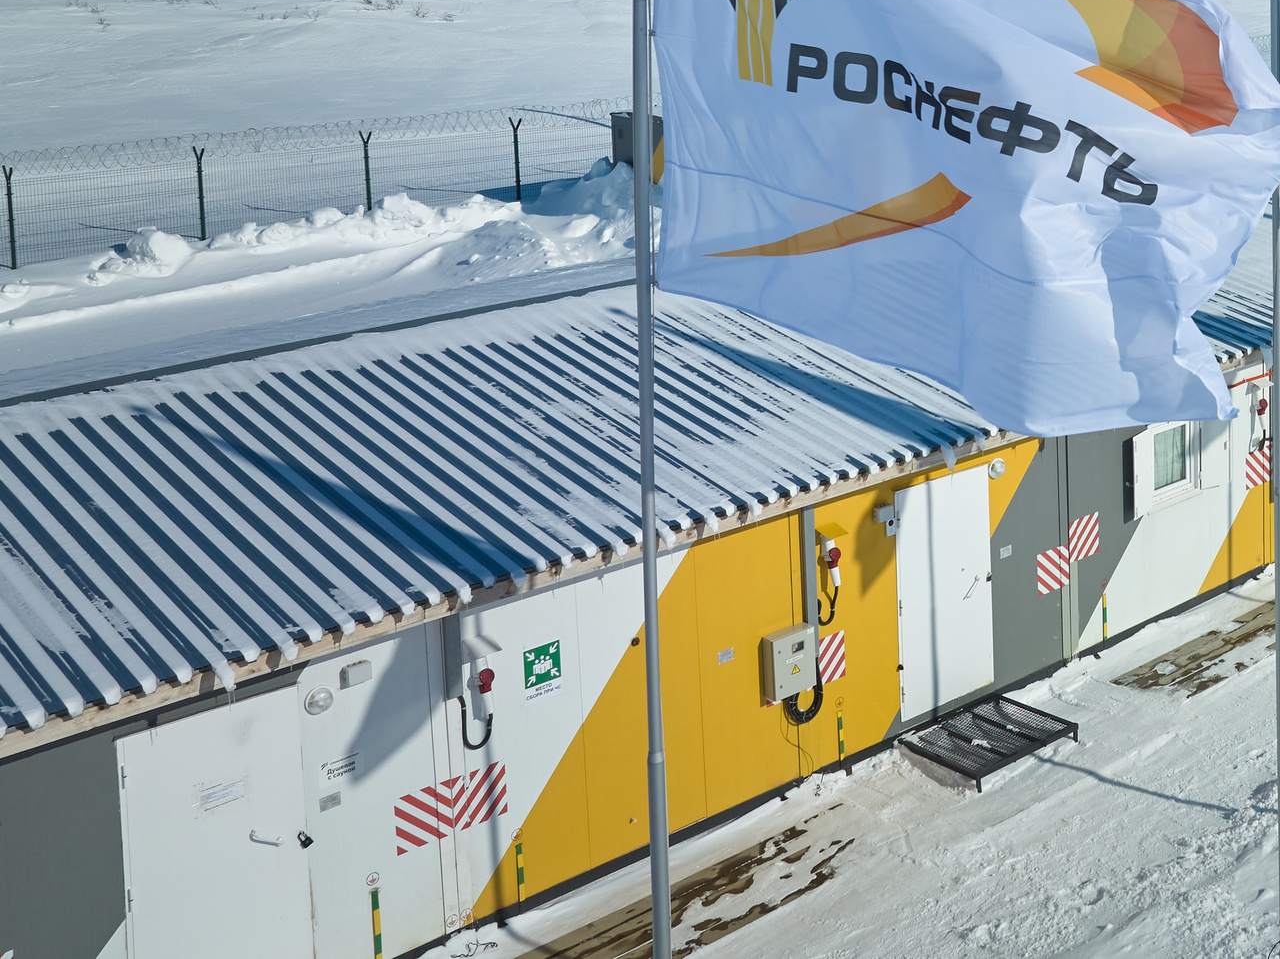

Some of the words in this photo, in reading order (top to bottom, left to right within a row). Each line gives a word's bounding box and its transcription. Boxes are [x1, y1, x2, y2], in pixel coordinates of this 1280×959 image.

[786, 43, 1159, 206] РОСНЕФТЬ
[526, 691, 543, 701] СБОРА
[544, 687, 554, 695] ПРИ
[535, 683, 552, 692] МЕСТО
[327, 761, 356, 776] Душевая
[333, 766, 356, 778] сауной
